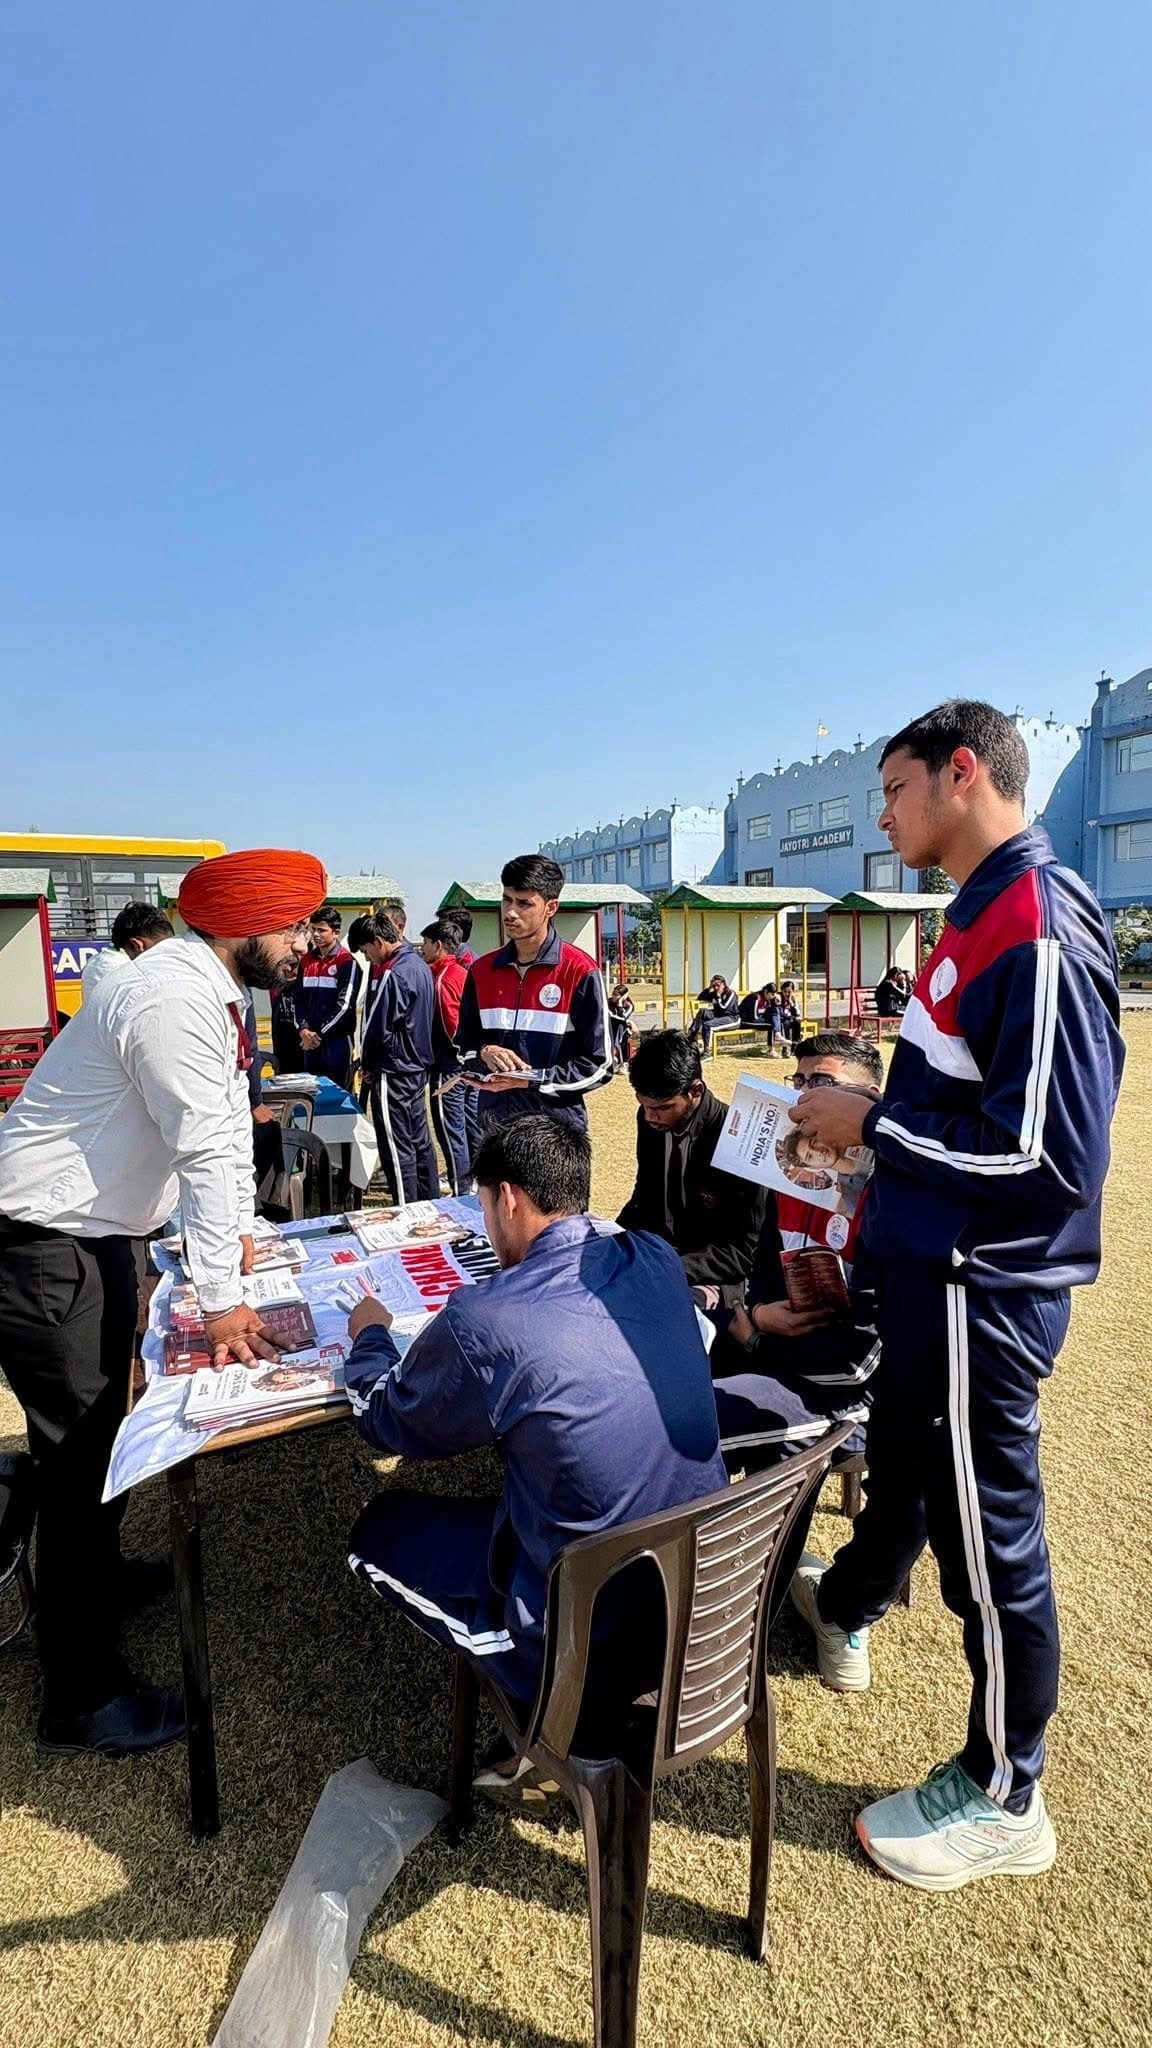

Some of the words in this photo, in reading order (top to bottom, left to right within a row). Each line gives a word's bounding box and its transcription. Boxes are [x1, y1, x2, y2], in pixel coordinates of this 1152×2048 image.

[780, 838, 810, 853] JAYOTRI
[812, 829, 852, 848] ACADEMY
[51, 947, 107, 974] AD
[750, 1126, 770, 1167] INDIA'S
[763, 1103, 778, 1127] NO.1
